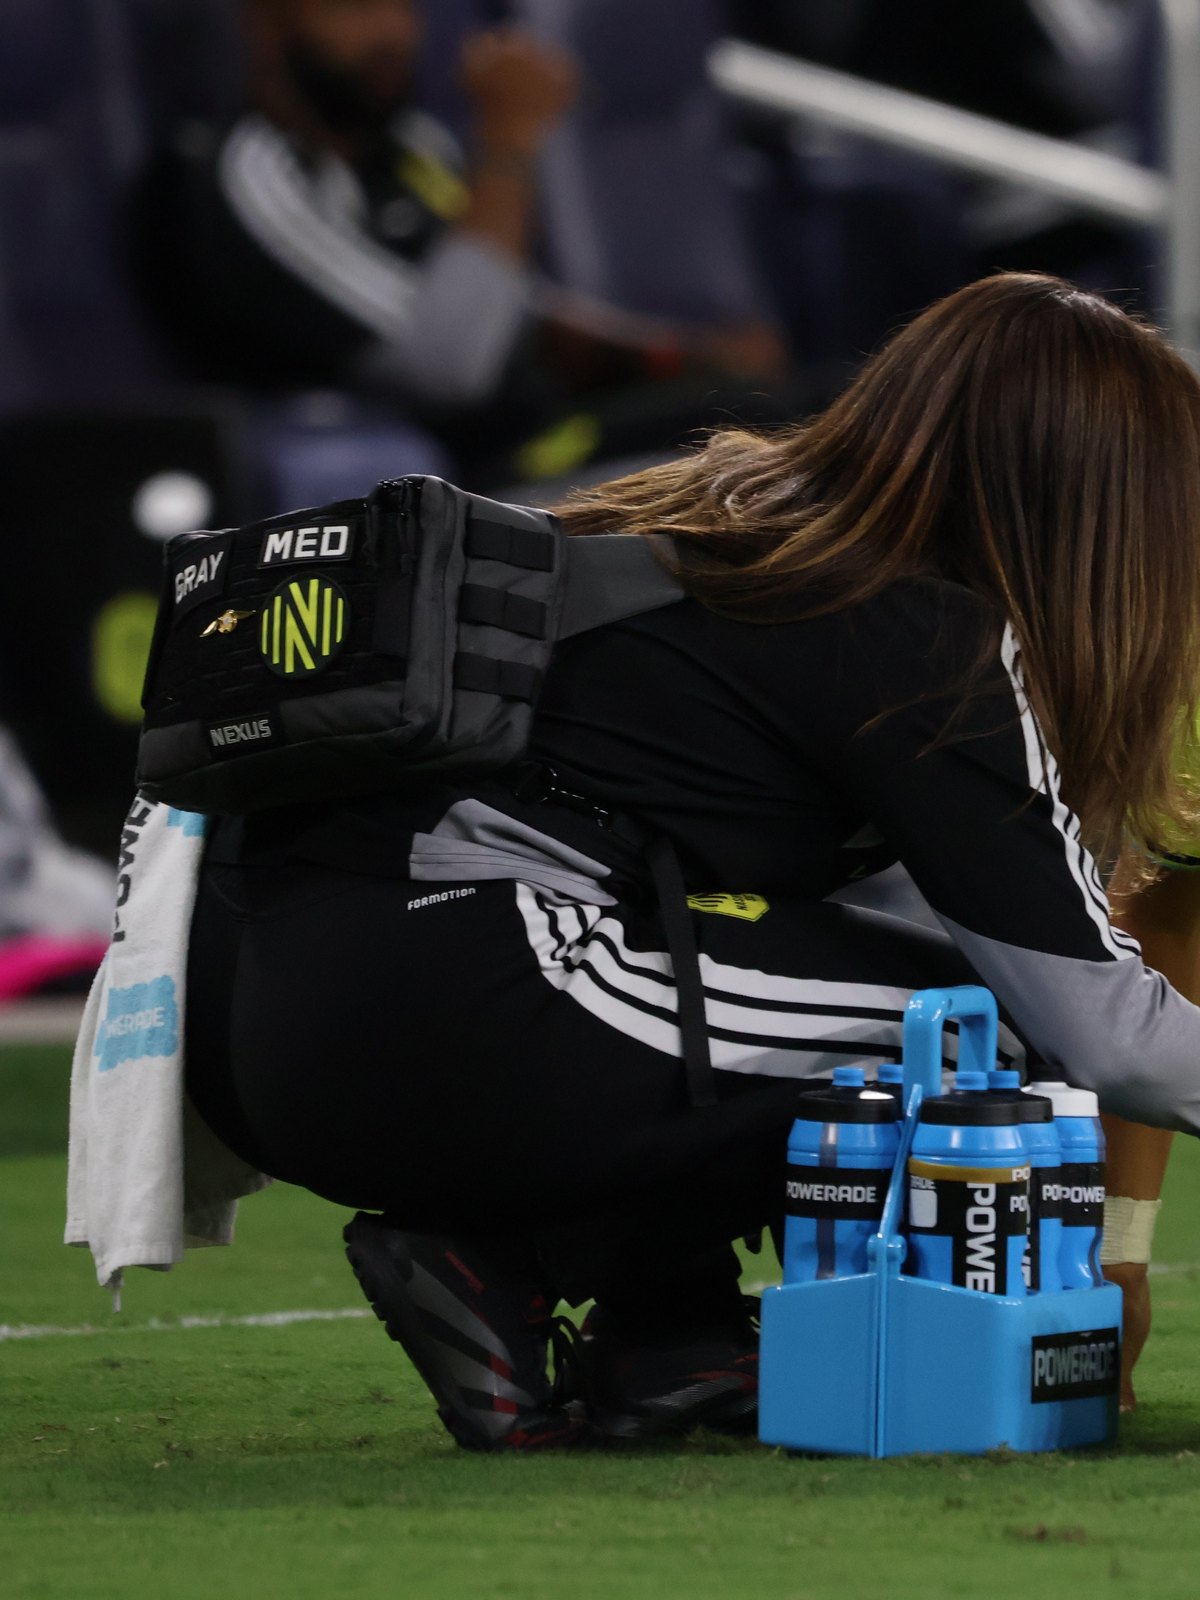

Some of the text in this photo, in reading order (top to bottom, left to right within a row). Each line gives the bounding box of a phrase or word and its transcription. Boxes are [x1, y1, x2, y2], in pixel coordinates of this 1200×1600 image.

[263, 524, 349, 563] MED
[175, 551, 224, 604] GRAY
[210, 719, 272, 748] NEXUS
[786, 1181, 877, 1203] POWERADE
